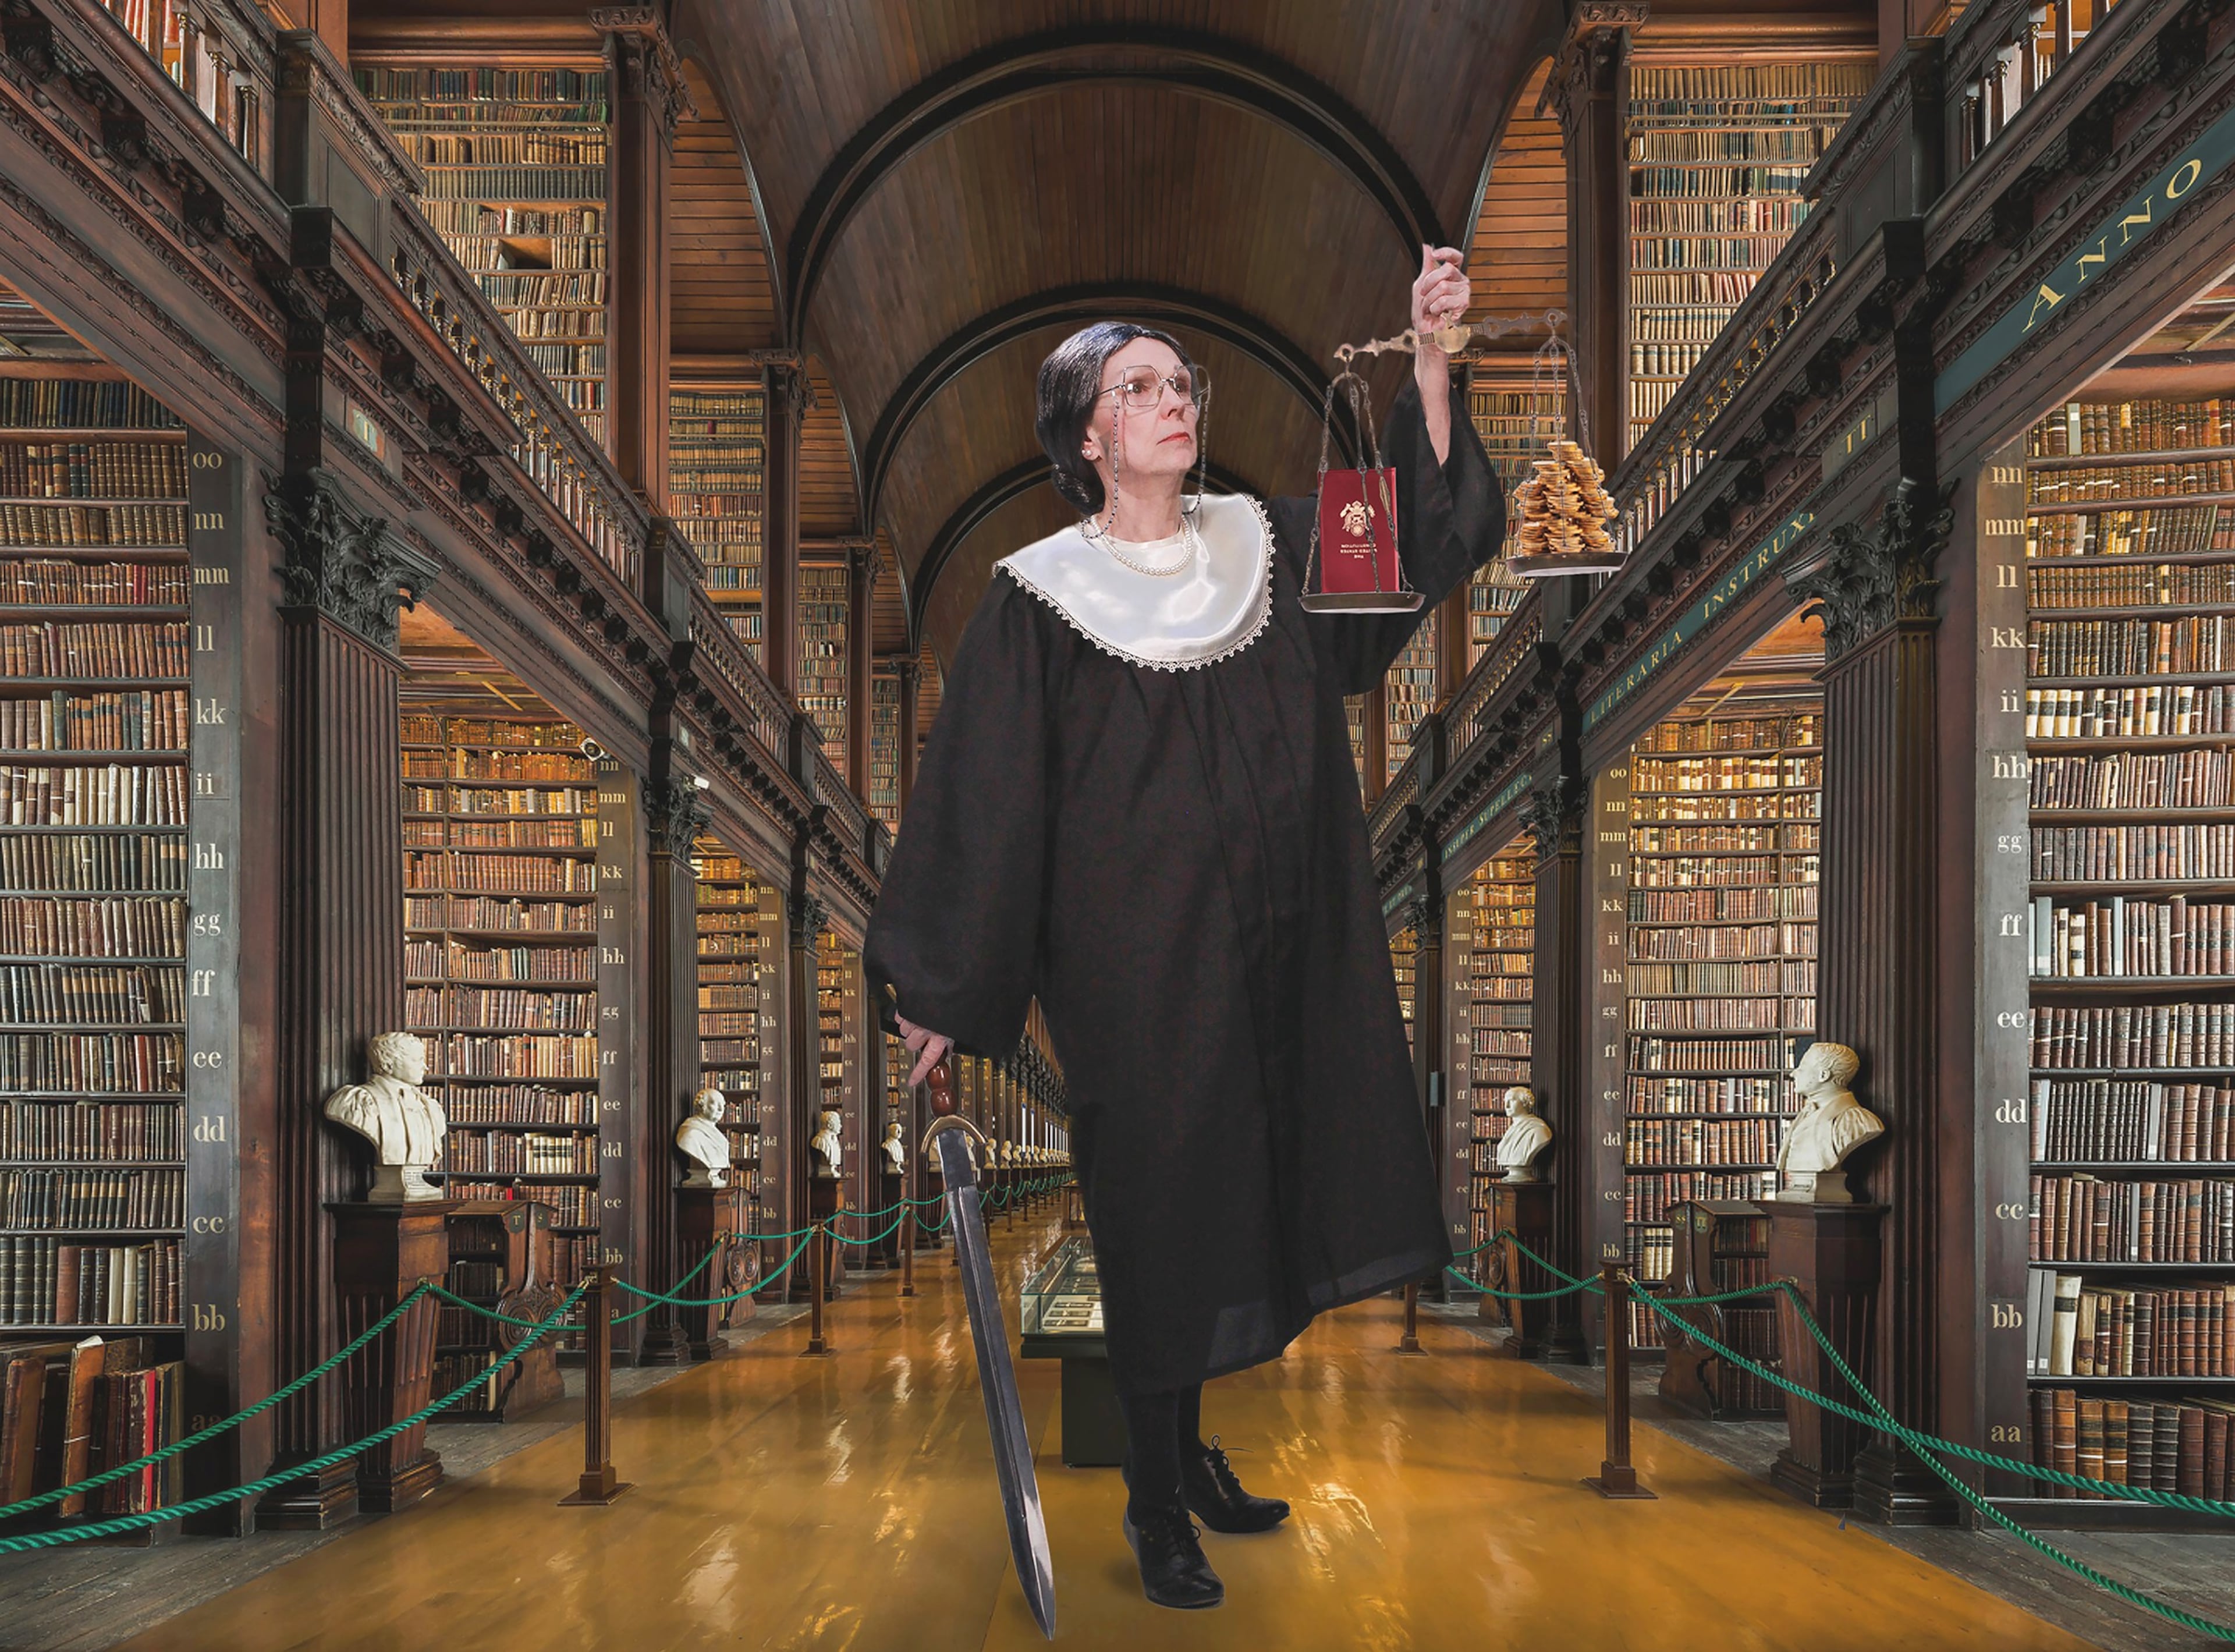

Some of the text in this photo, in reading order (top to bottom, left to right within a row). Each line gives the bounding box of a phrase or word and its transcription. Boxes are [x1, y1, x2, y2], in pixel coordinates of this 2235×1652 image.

[2021, 159, 2202, 334] ANNO
[193, 453, 222, 469] oo
[1992, 467, 2023, 483] nn
[194, 512, 224, 529] nn
[1985, 517, 2025, 536] mm
[193, 566, 230, 583] mm
[1996, 565, 2018, 587] ll
[196, 626, 215, 651] ll
[1991, 627, 2024, 647] kk
[1590, 632, 1683, 724] LITERARIA
[2000, 690, 2020, 712] ii
[195, 700, 225, 724] kk
[601, 760, 619, 771] nn
[1610, 769, 1627, 778] oo
[1993, 756, 2026, 778] hh
[196, 774, 214, 794] ii
[600, 793, 626, 802] mm
[1606, 802, 1626, 811] nn
[602, 822, 613, 836] ll
[1601, 832, 1626, 841] mm
[1998, 836, 2021, 853] gg
[194, 844, 224, 868] hh
[602, 866, 623, 878] kk
[1610, 864, 1621, 876] ll
[604, 906, 613, 919] ii
[1602, 900, 1623, 910] kk
[193, 913, 220, 935] gg
[1999, 914, 2022, 935] ff
[1608, 933, 1619, 945] ii
[602, 948, 625, 963] hh
[191, 970, 215, 995] ff
[1603, 970, 1622, 982] hh
[1997, 1012, 2024, 1028] ee
[193, 1051, 221, 1067] ee
[602, 1051, 617, 1065] ff
[1603, 1045, 1617, 1057] ff
[1603, 1090, 1620, 1100] ee
[604, 1101, 620, 1111] ee
[1995, 1100, 2026, 1123] dd
[193, 1116, 226, 1142] dd
[1603, 1133, 1620, 1146] dd
[603, 1143, 622, 1157] dd
[1996, 1203, 2023, 1219] cc
[193, 1216, 225, 1233] cc
[513, 1215, 521, 1225] T
[606, 1249, 623, 1264] bb
[1603, 1245, 1620, 1257] bb
[193, 1304, 225, 1331] bb
[1991, 1304, 2022, 1328] bb
[1991, 1426, 2021, 1442] aa
